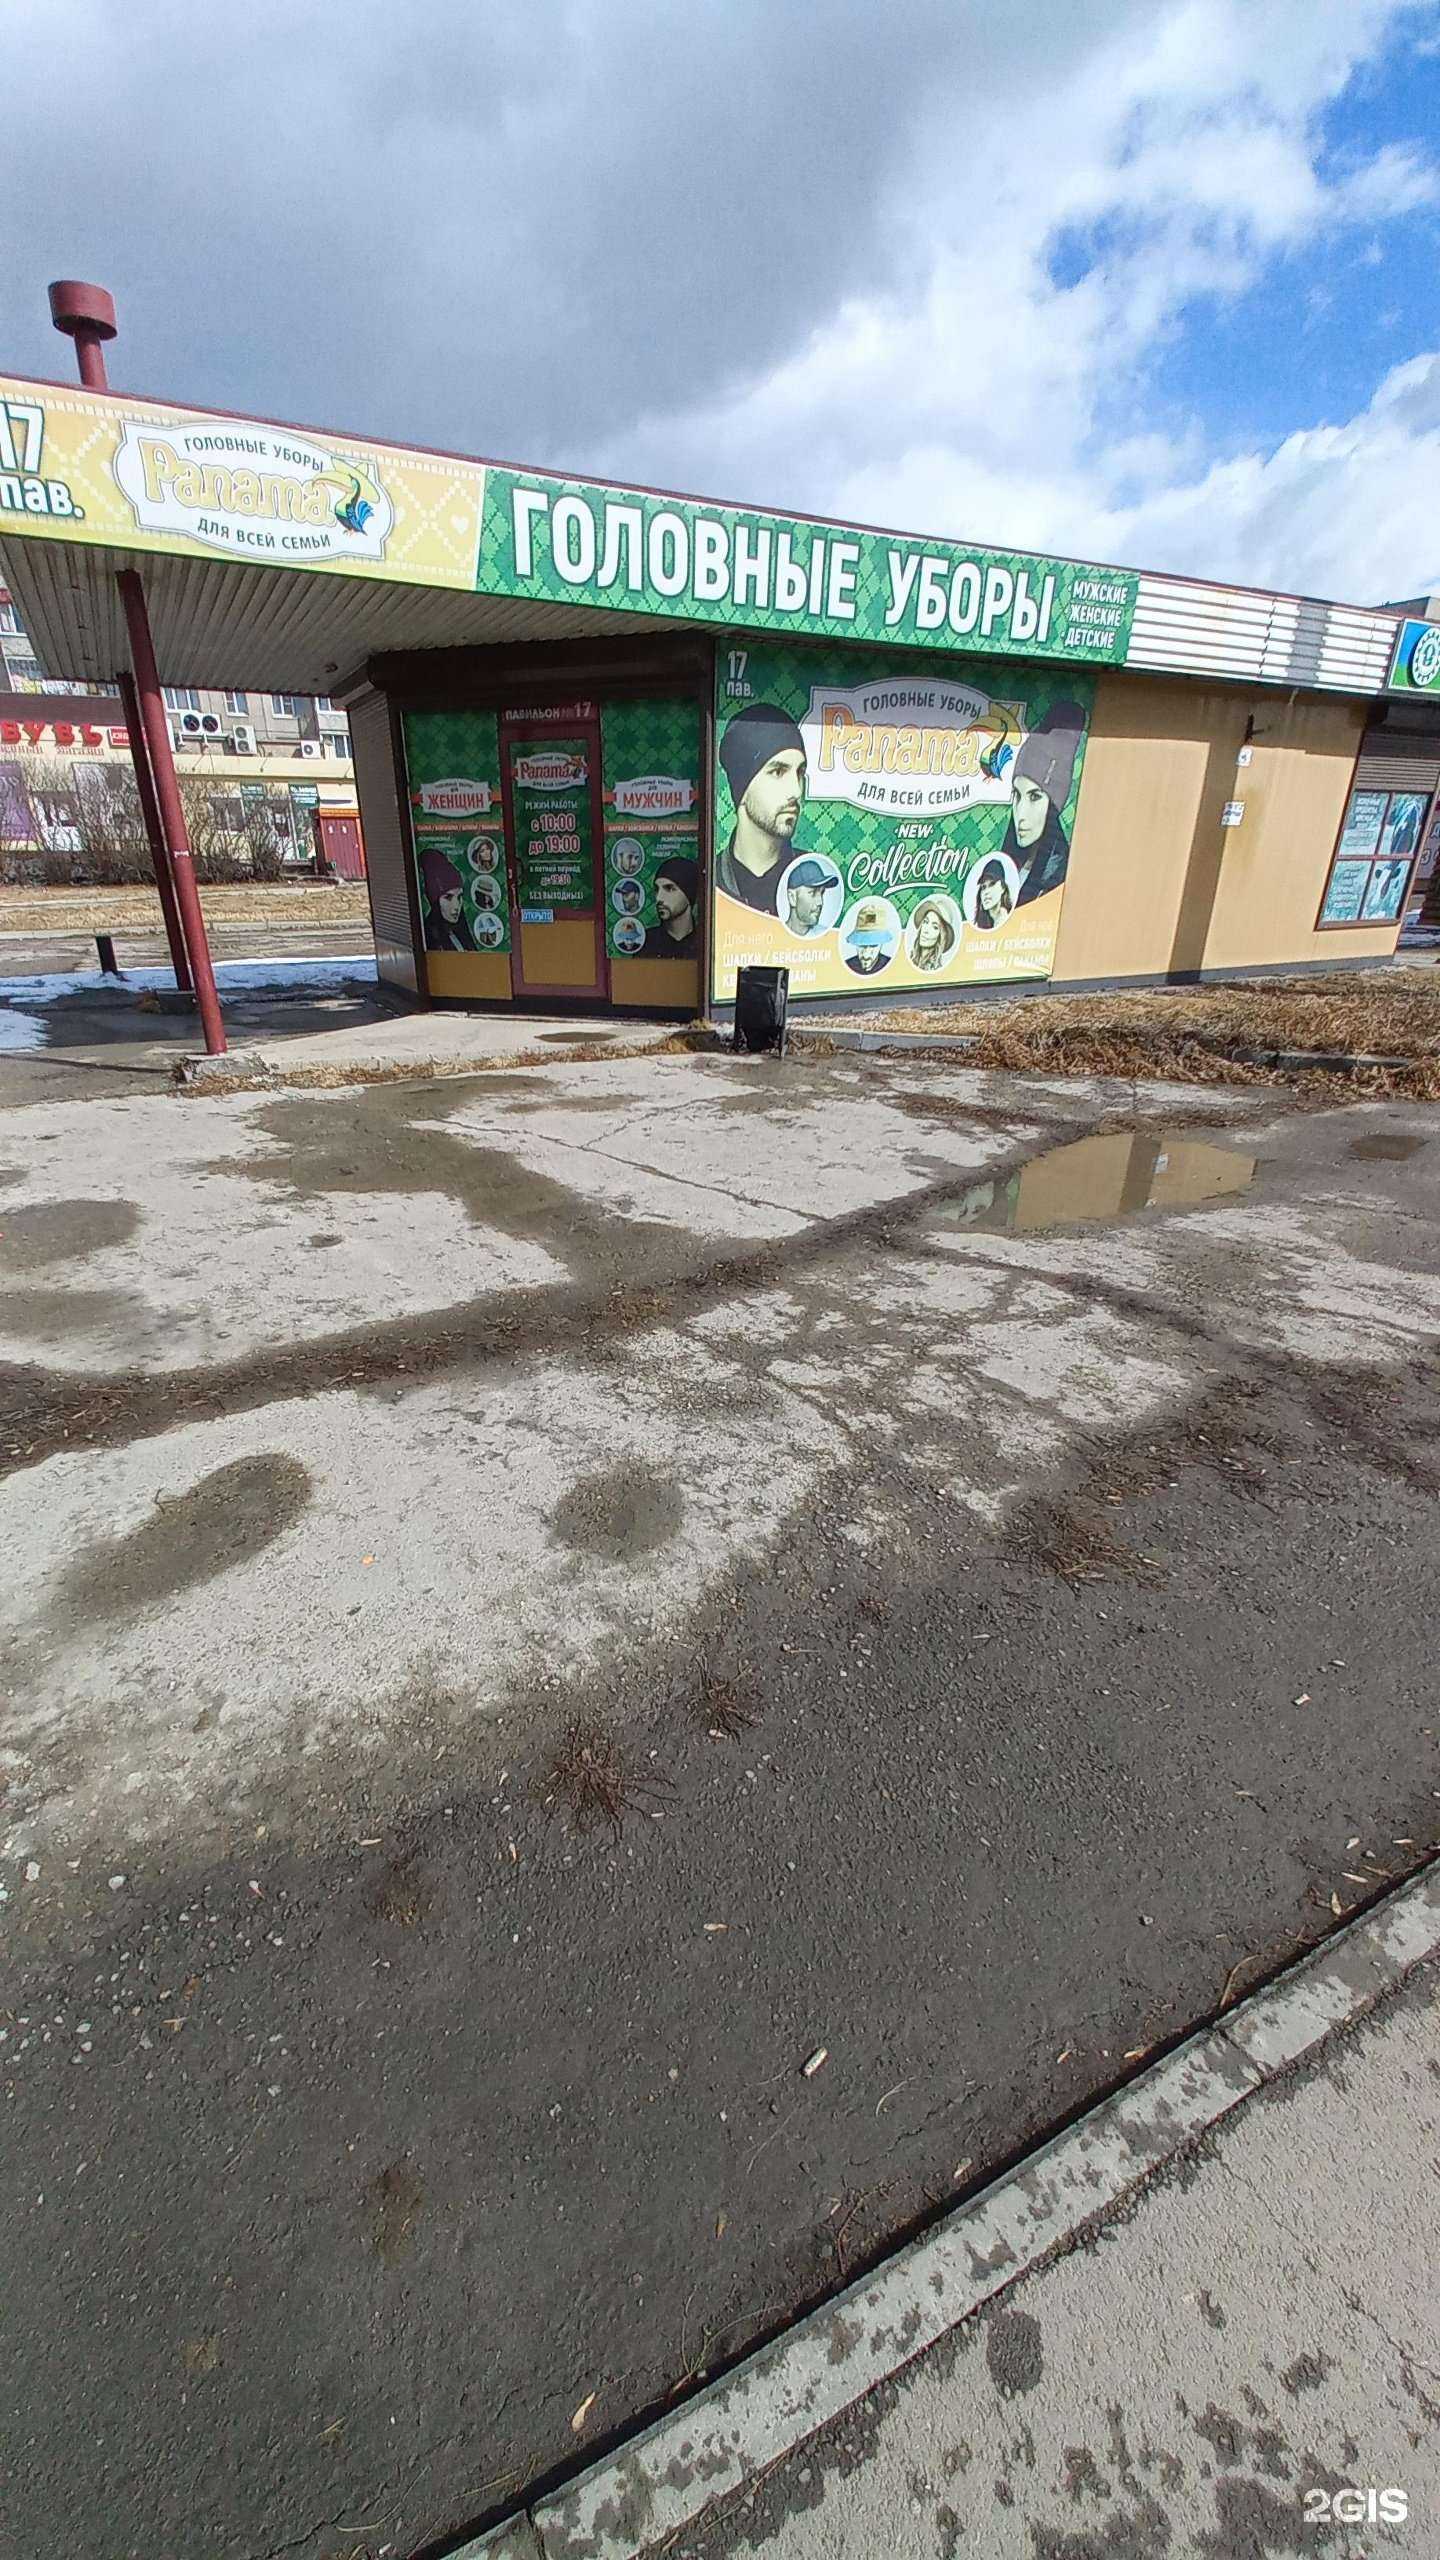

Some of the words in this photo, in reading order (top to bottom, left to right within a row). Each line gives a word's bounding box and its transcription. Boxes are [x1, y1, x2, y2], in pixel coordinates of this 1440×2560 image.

[184, 437, 268, 456] ГОЛОВНЫЕ
[273, 445, 324, 472] УБОРЫ
[138, 438, 338, 527] Panama
[197, 518, 230, 540] ДЛЯ
[236, 531, 276, 549] ВСЕЙ
[281, 533, 332, 550] СЕМЬИ
[511, 486, 860, 620] ГОЛОВНЫЕ
[884, 549, 1055, 643] УБОРЫ
[1072, 580, 1129, 605] МУЖСКИЕ
[1068, 604, 1122, 627] ЖЕНСКИЕ
[1064, 627, 1115, 649] ДЕТСКИЕ
[727, 650, 748, 680] 17
[726, 681, 755, 698] пав.
[505, 707, 560, 721] ПАВИЛЬОН
[574, 701, 592, 718] 17
[863, 692, 935, 714] ГОЛОВНЫЕ
[939, 695, 982, 719] УБОРЫ
[818, 703, 981, 777] Panama
[520, 761, 573, 779] Panama
[428, 791, 485, 811] ЖЕНЩИН
[623, 791, 683, 809] МУЖЧИН
[857, 782, 885, 801] ДЛЯ
[890, 789, 923, 805] ВСЕЙ
[928, 784, 970, 805] СЕМЬИ
[540, 813, 576, 832] 10:00
[897, 823, 932, 838] NEW
[529, 841, 544, 855] до
[545, 835, 580, 854] 19:00
[847, 835, 971, 892] Collection
